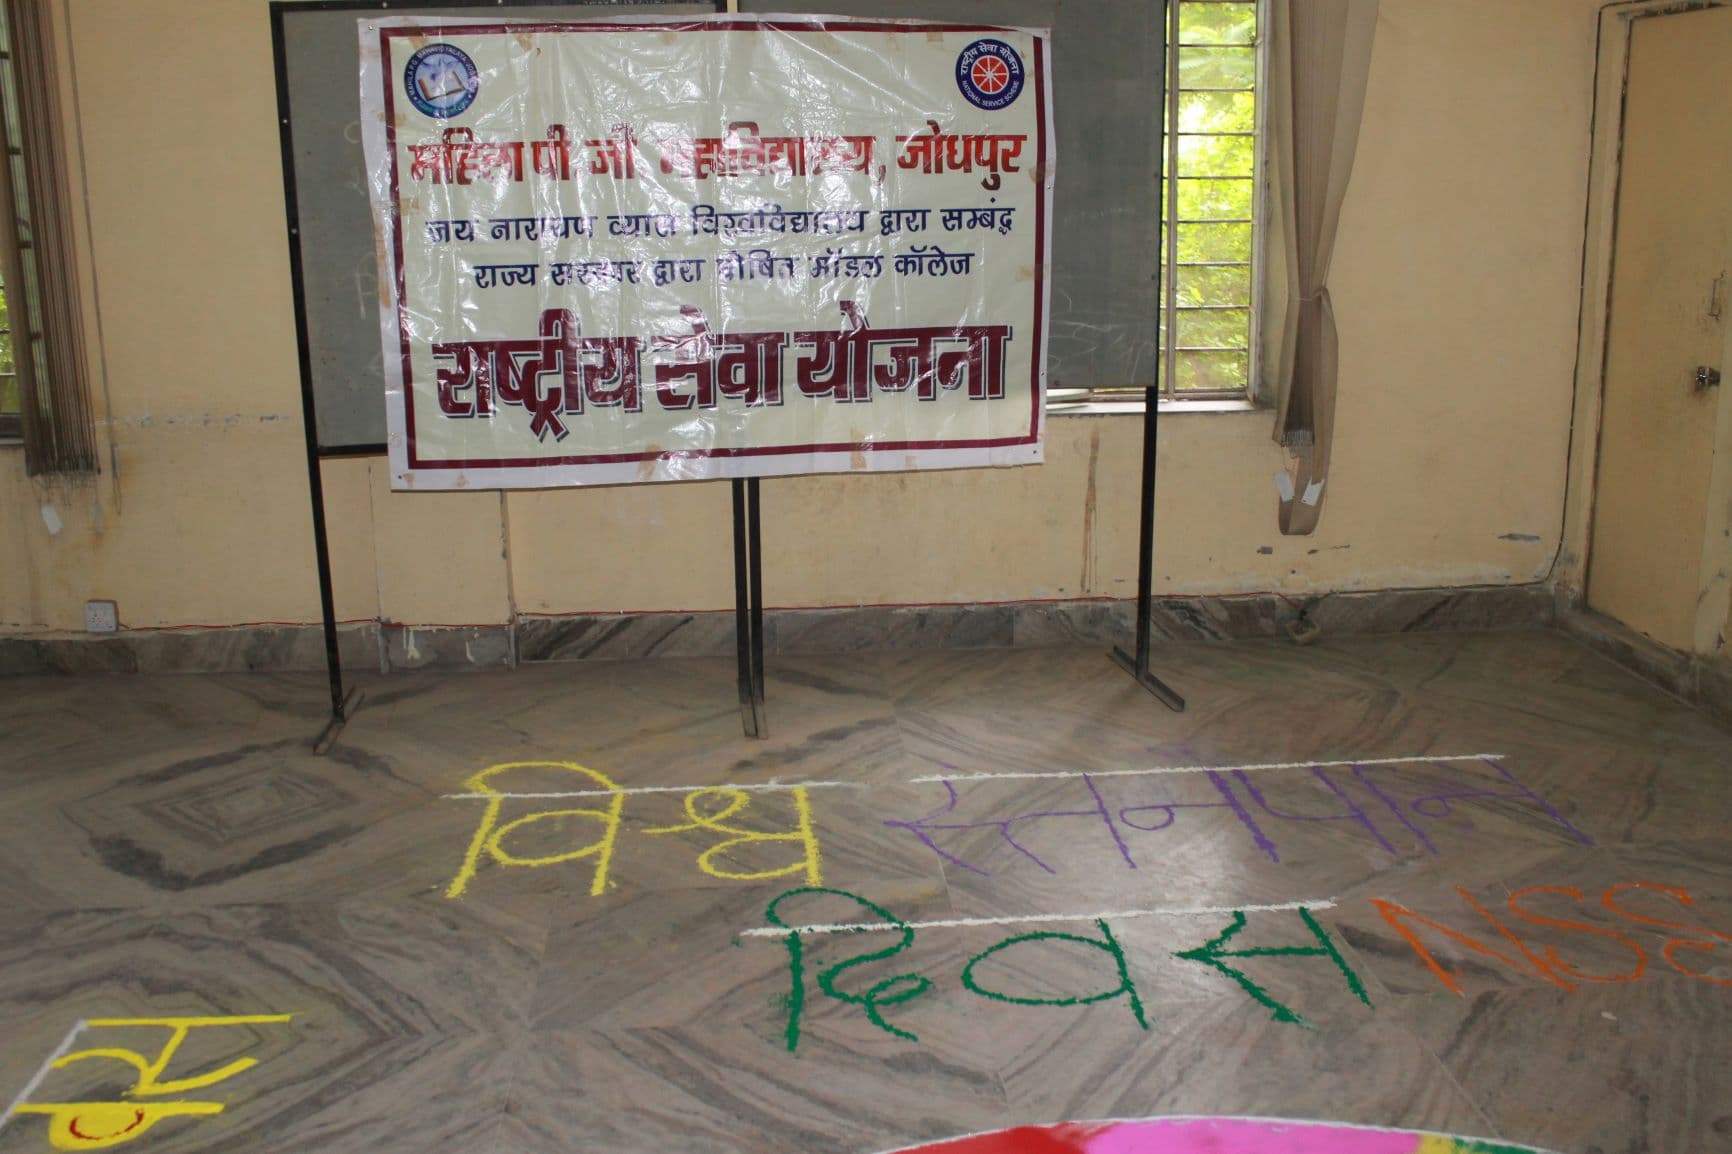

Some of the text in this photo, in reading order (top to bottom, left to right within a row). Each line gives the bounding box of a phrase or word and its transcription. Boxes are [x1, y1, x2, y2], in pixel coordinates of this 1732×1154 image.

[977, 42, 999, 53] सेवा
[1000, 46, 1019, 75] योजना
[982, 97, 1006, 107] SERVICE
[896, 120, 1027, 191] जोधपुर
[426, 219, 479, 243] जय
[488, 216, 597, 241] नारायण
[607, 214, 679, 239] व्यास
[880, 209, 931, 236] द्वारा
[473, 264, 539, 288] राज्य
[652, 259, 706, 287] द्वारा
[808, 247, 884, 278] मॉडल
[894, 245, 975, 276] कॉलेज
[431, 300, 1012, 442] राष्ट्रीय सेवा योजना
[1368, 881, 1732, 998] NSS
[740, 887, 1375, 1052] दिवस
